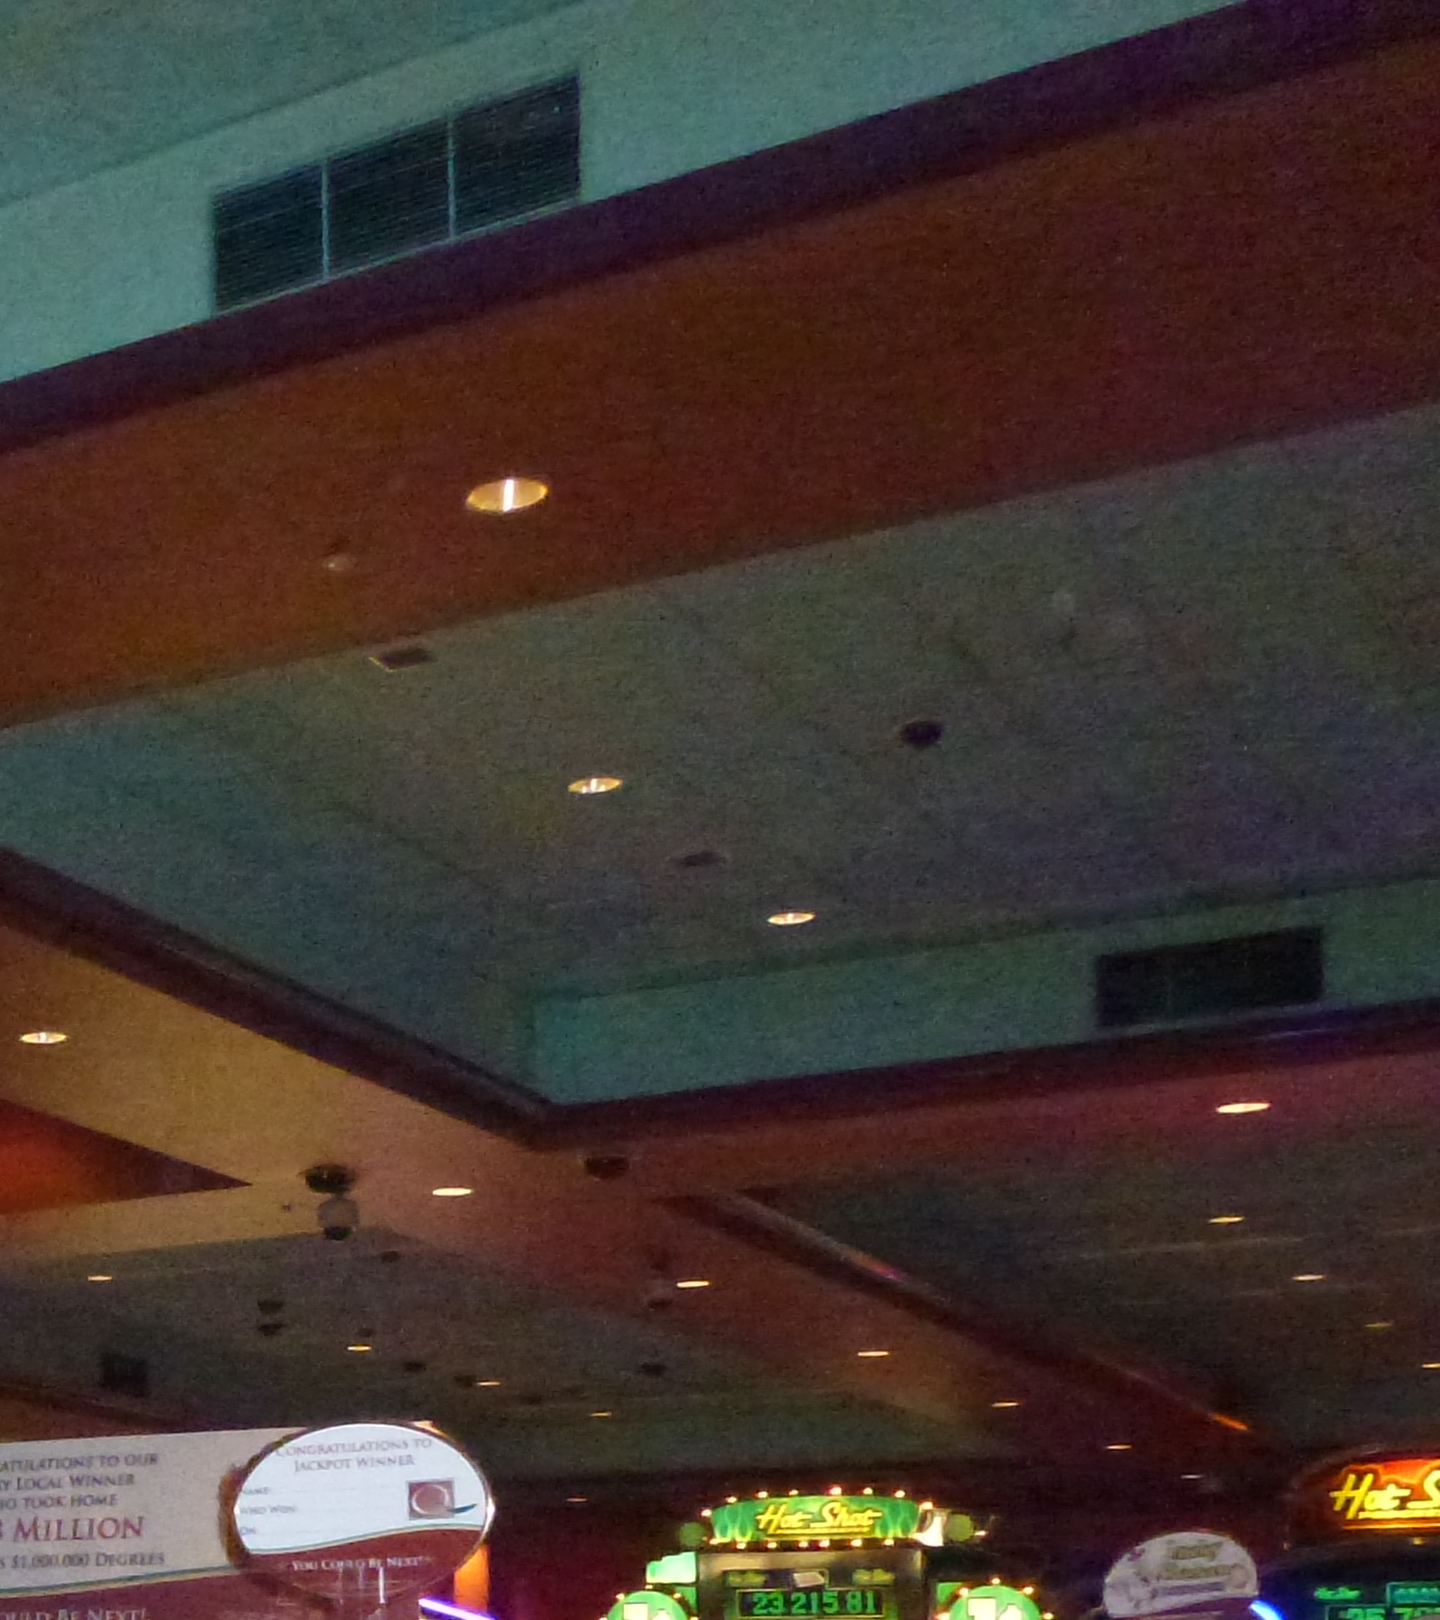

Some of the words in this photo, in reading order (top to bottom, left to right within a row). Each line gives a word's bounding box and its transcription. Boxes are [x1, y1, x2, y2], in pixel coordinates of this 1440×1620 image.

[276, 1438, 408, 1457] CONGRATULATIONS
[413, 1437, 432, 1449] TO
[99, 1455, 119, 1467] TO
[125, 1453, 159, 1467] OUR
[294, 1457, 352, 1473] JACKPOT
[356, 1455, 416, 1468] WINNER
[17, 1476, 63, 1491] LOCAL
[70, 1473, 136, 1488] WINNER
[23, 1496, 64, 1510] TOOK
[70, 1493, 118, 1507] HOME
[1329, 1474, 1411, 1519] Hot
[756, 1504, 812, 1533] Hot
[810, 1502, 882, 1528] Shot
[13, 1516, 145, 1542] MILLION
[95, 1551, 165, 1567] DEGREES
[292, 1559, 317, 1572] YOU
